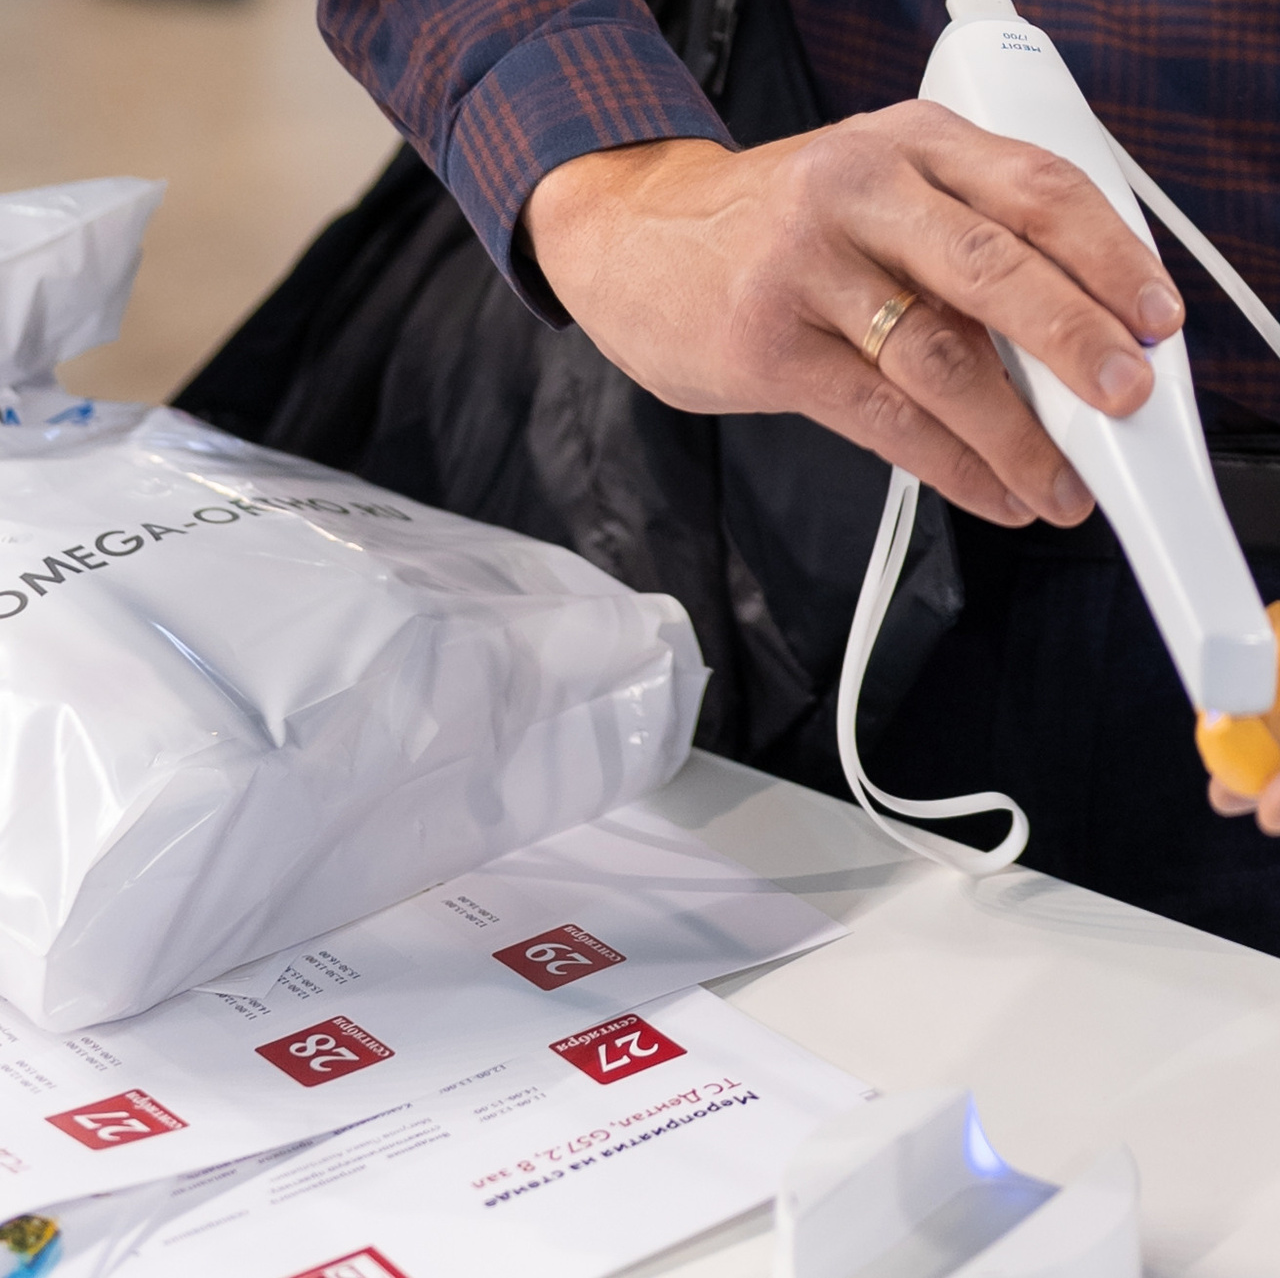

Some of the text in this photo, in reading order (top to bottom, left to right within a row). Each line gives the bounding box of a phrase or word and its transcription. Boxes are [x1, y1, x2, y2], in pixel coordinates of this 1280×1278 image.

[1001, 42, 1042, 53] MEDIT
[525, 942, 593, 976] 29
[563, 925, 621, 962] сентября
[289, 1033, 360, 1072] 28
[332, 1017, 391, 1057] сентября
[556, 1016, 638, 1053] сентября
[597, 1031, 659, 1073] 27
[703, 1077, 742, 1095] ТС
[72, 1111, 152, 1142] 27
[609, 1088, 702, 1128] Дентал,
[484, 1090, 760, 1207] Мероприятия на стенде
[517, 1160, 535, 1172] 8
[471, 1169, 512, 1188] зал
